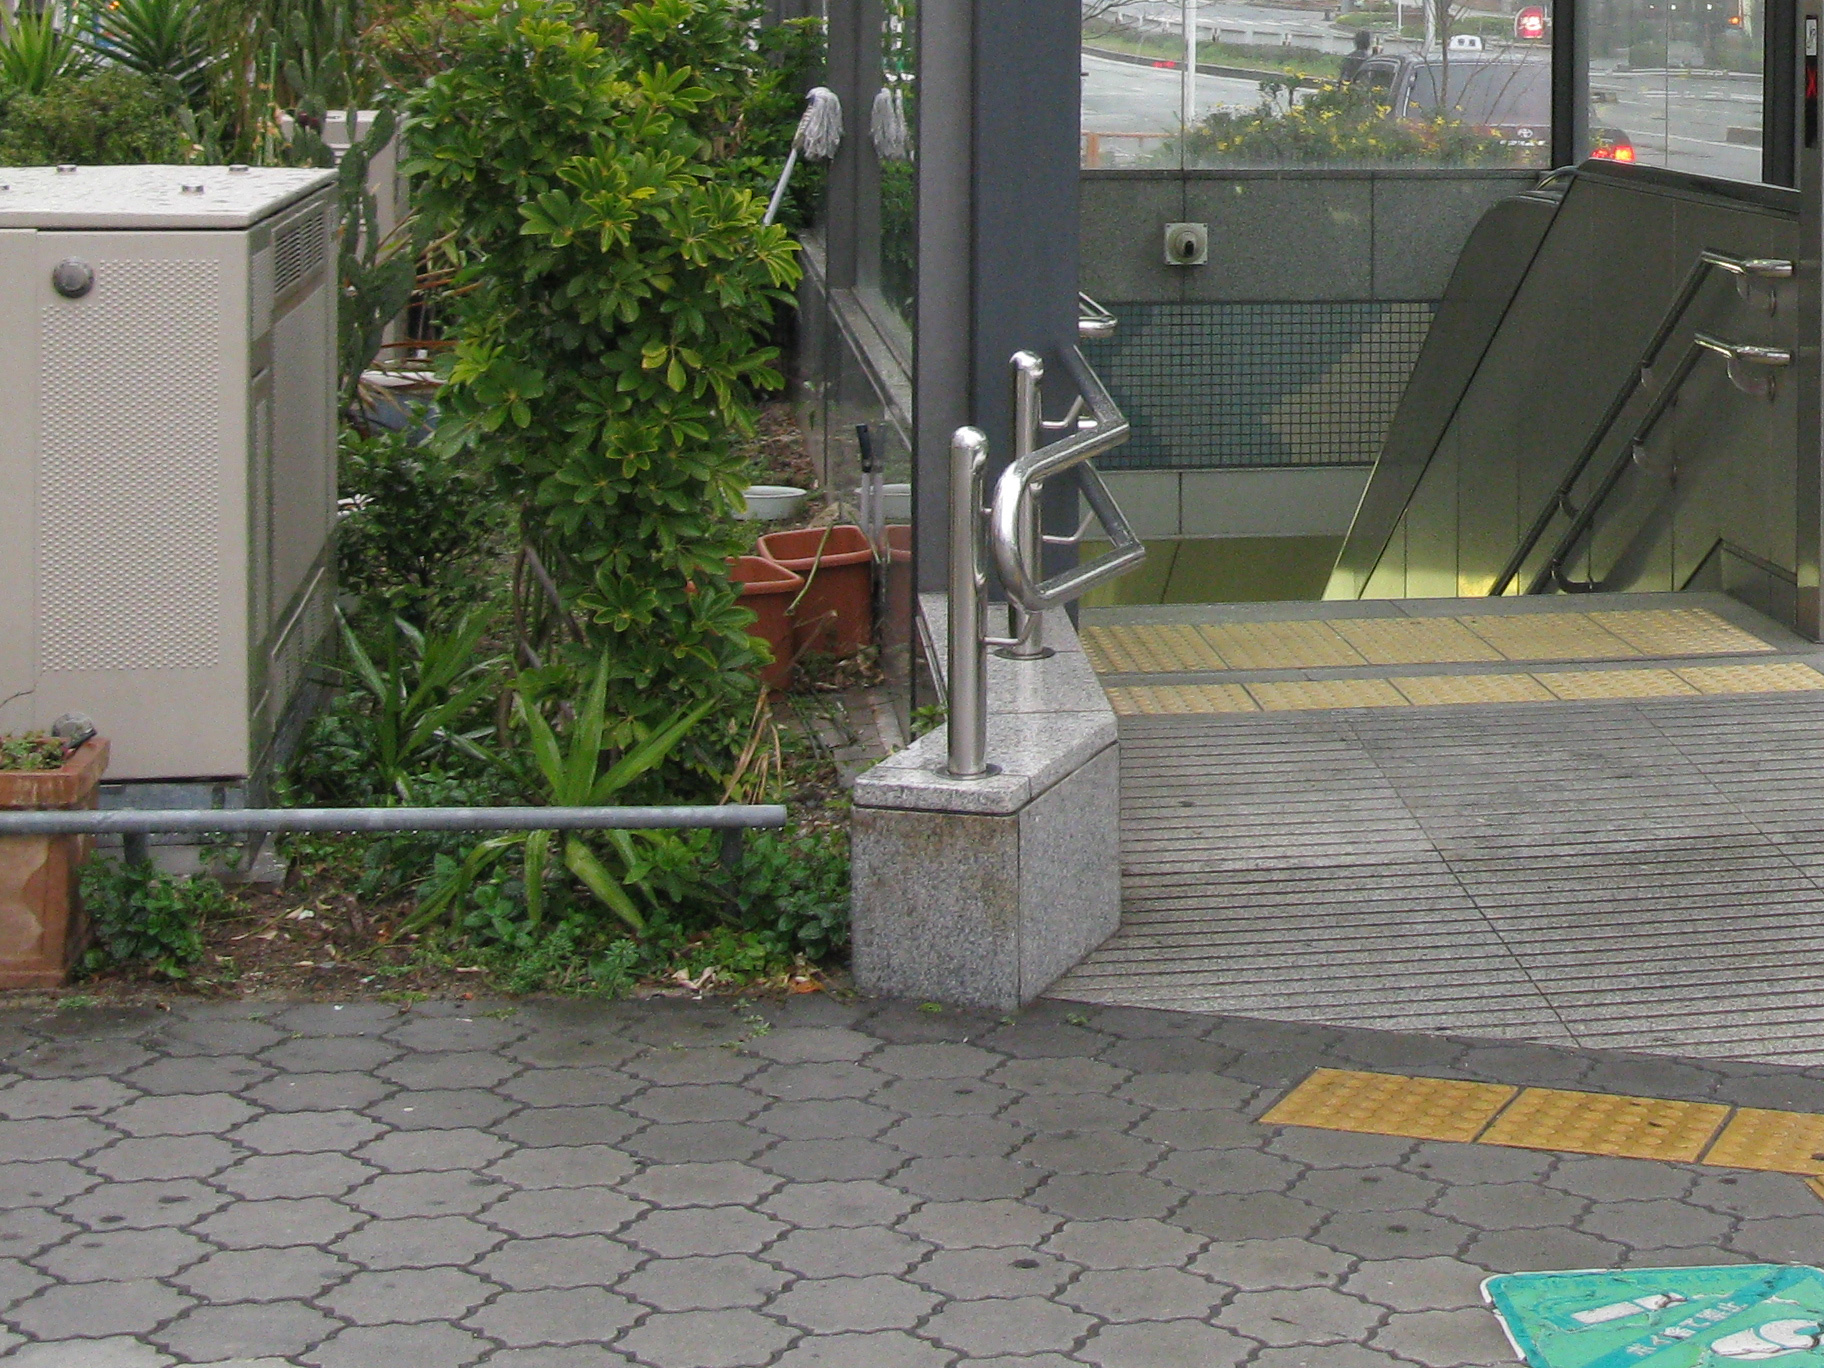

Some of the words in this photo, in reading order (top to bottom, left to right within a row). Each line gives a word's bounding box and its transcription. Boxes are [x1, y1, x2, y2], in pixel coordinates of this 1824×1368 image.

[1625, 1301, 1750, 1357] ポイ捨て禁止
